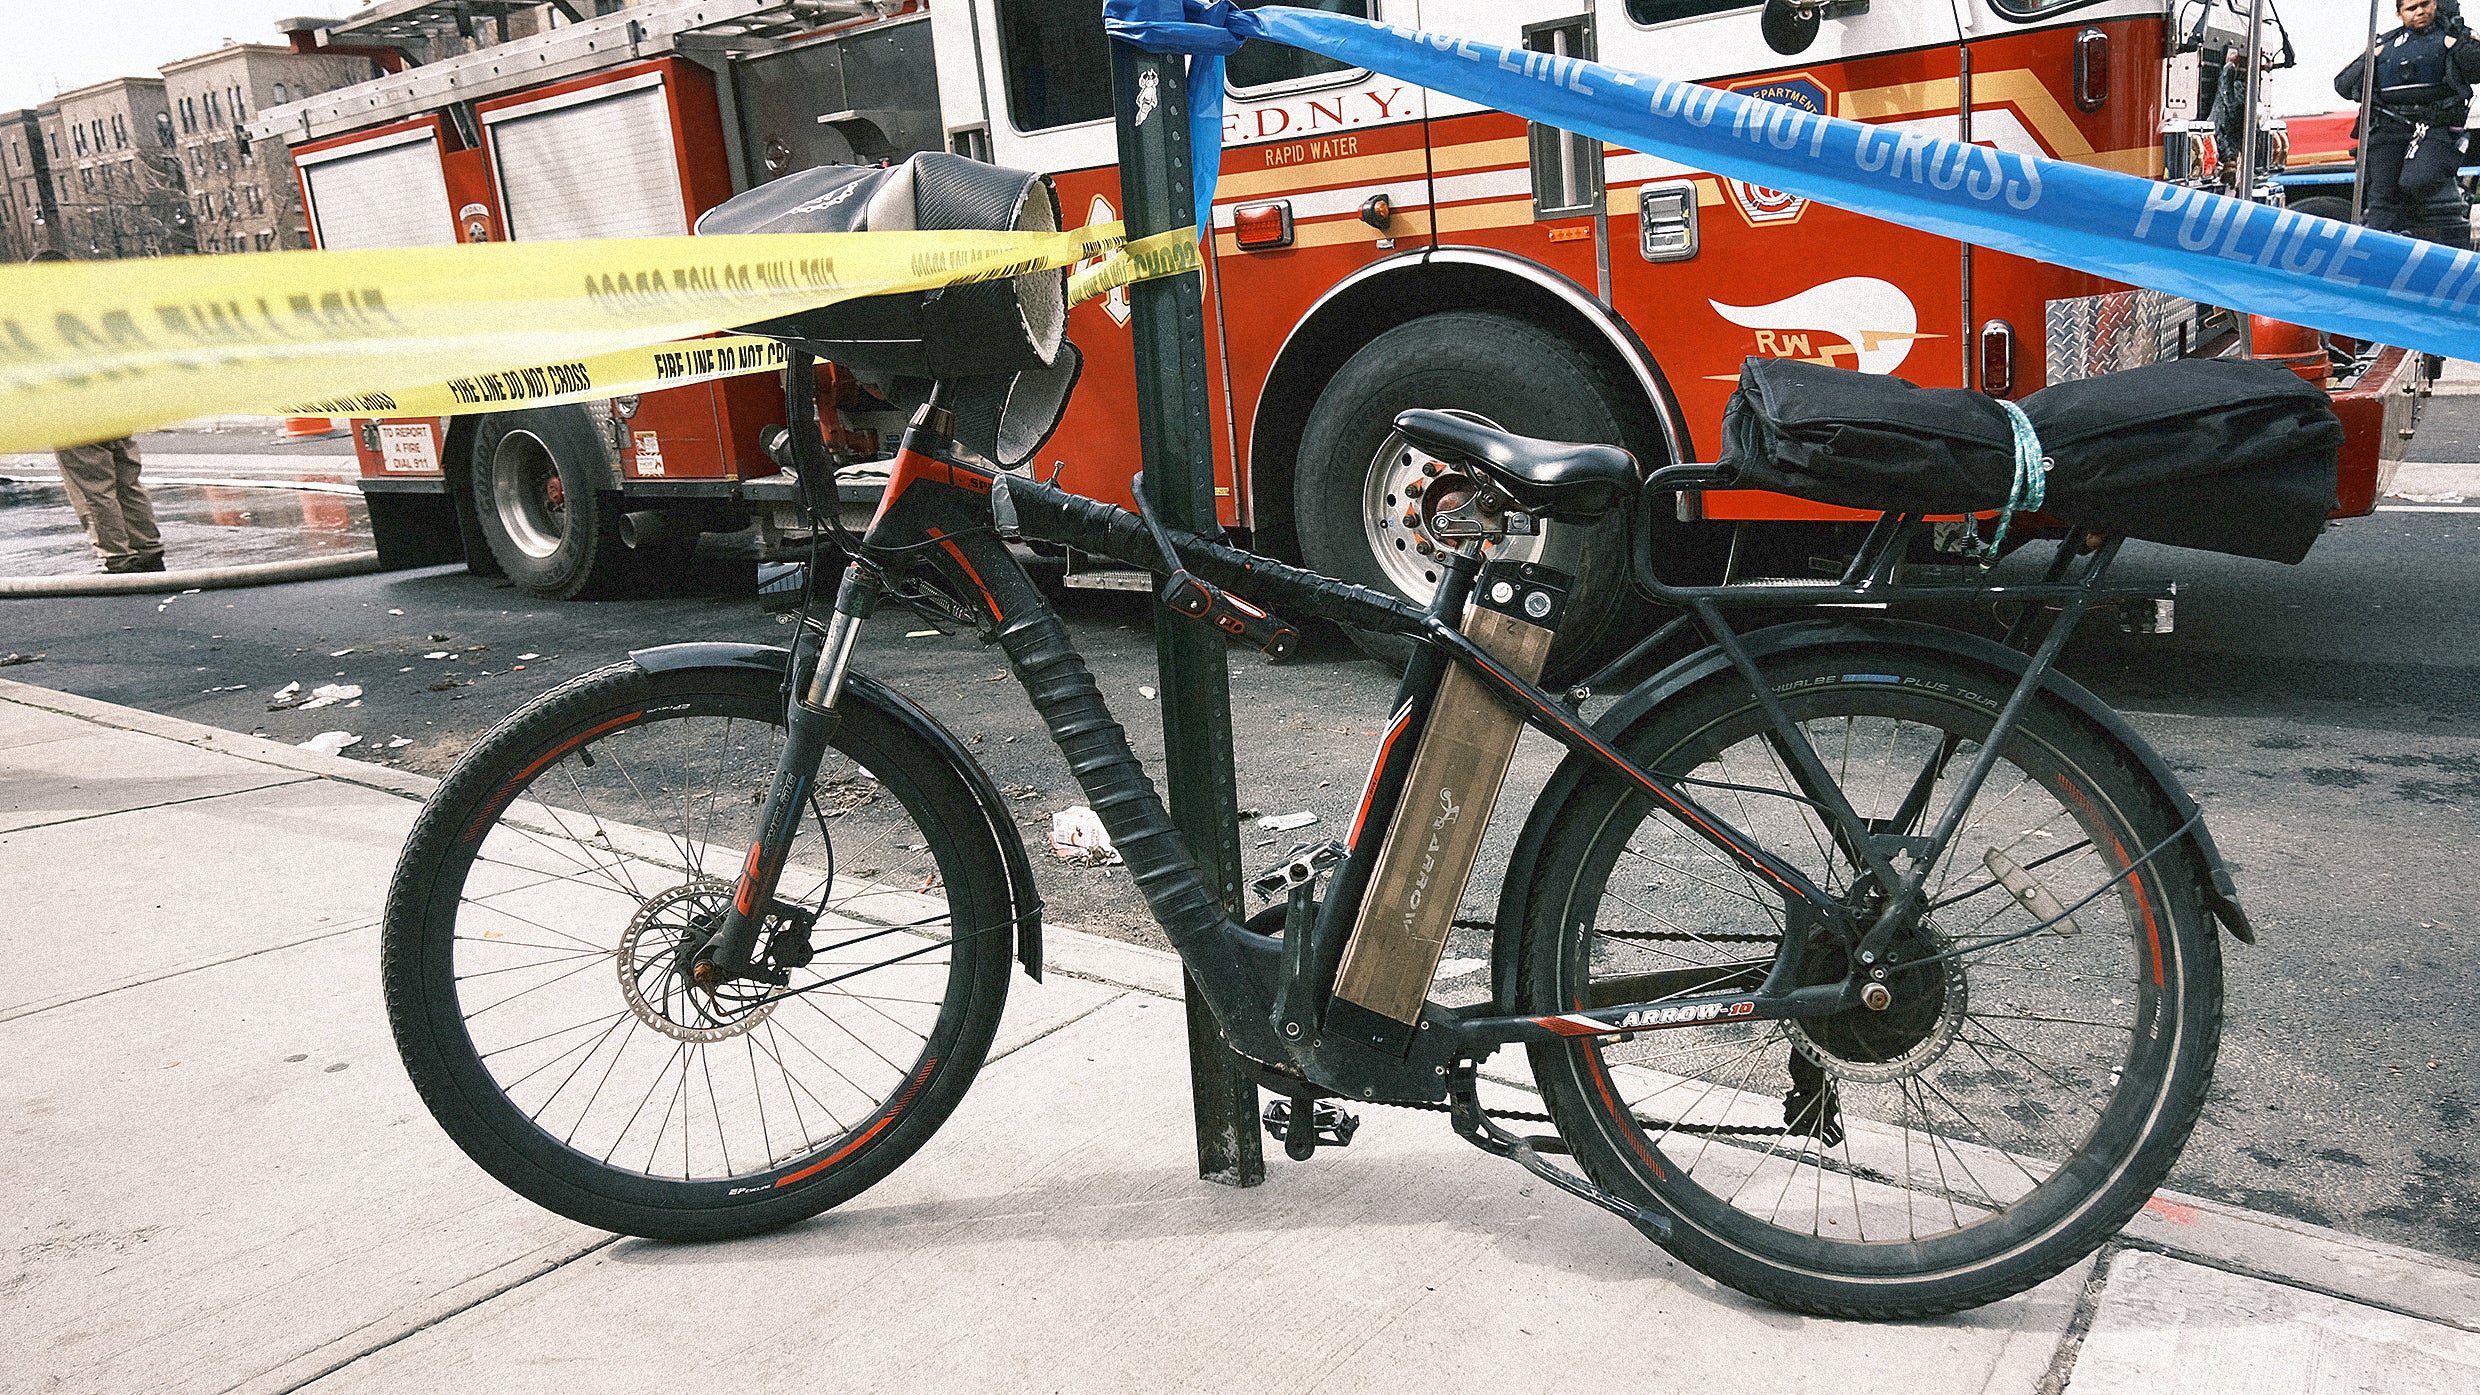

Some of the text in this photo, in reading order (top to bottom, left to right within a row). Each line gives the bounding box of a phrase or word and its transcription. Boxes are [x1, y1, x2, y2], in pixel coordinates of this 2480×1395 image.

[1265, 136, 1358, 166] RAPID WATER
[1731, 94, 1833, 159] NOT
[1854, 124, 2046, 210] CROSS
[2133, 179, 2371, 288] POLICE
[1755, 330, 1811, 357] RW
[718, 347, 735, 371] DO
[738, 344, 763, 370] NOT
[446, 362, 590, 403] FIRE LINE DO NOT CROSS
[382, 427, 427, 437] TO REPORT
[395, 443, 421, 453] A FIRE
[393, 459, 428, 468] DIAL 911
[1903, 677, 1951, 692] PLUS
[1955, 687, 1999, 710] TOUR
[1620, 1002, 1755, 1028] ARROW-10
